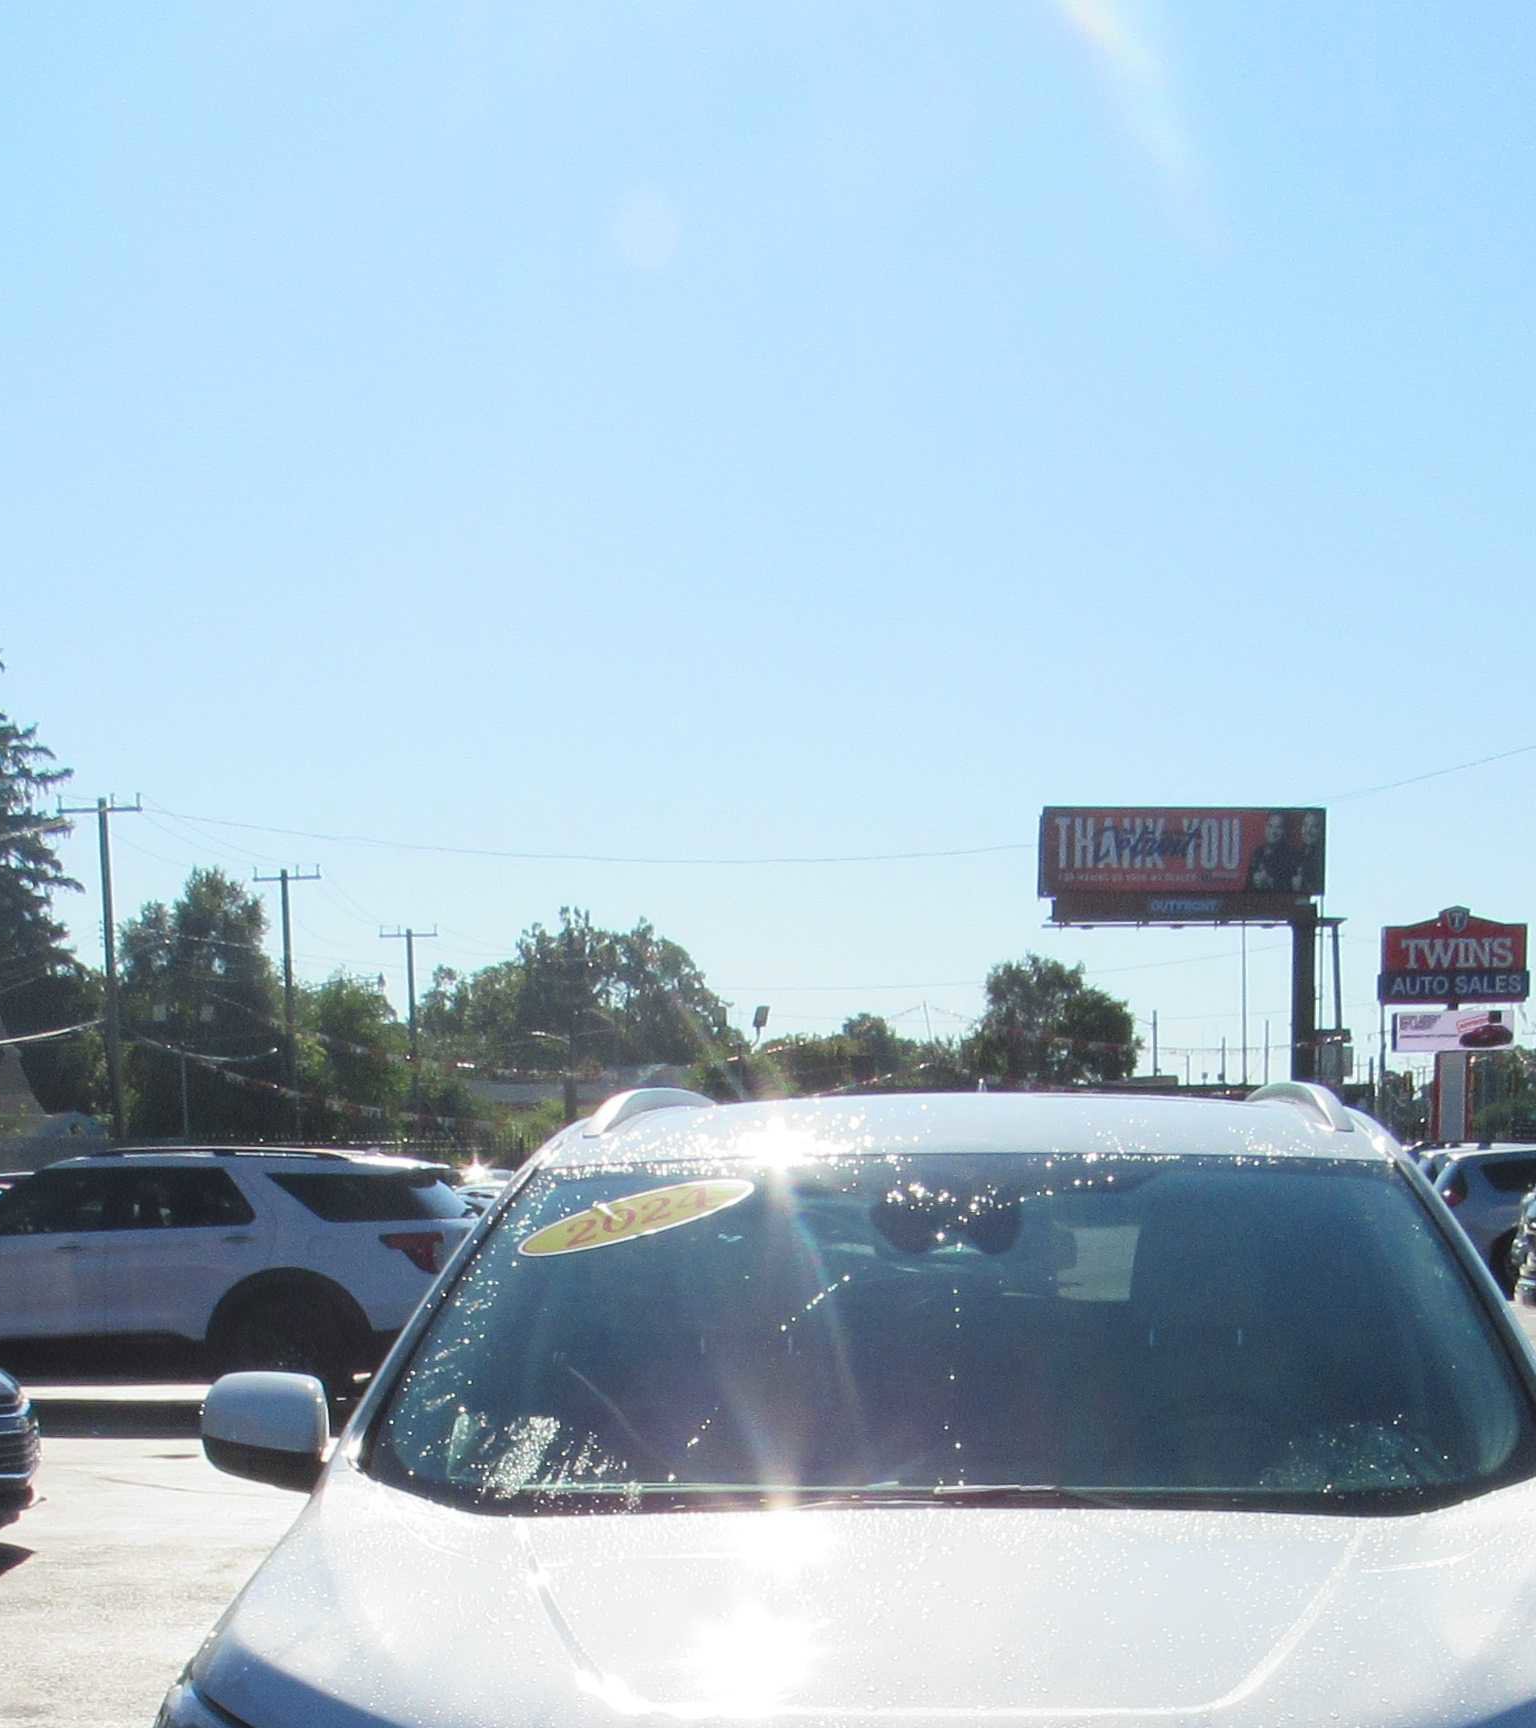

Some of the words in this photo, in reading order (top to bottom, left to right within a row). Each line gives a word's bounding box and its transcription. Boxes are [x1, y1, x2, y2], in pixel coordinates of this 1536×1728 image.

[1055, 816, 1166, 869] THANK
[1183, 817, 1242, 870] YOU
[1401, 937, 1514, 970] TWINS
[1392, 976, 1449, 996] AUTO
[1454, 974, 1521, 994] SALES
[566, 1187, 709, 1248] 2024
